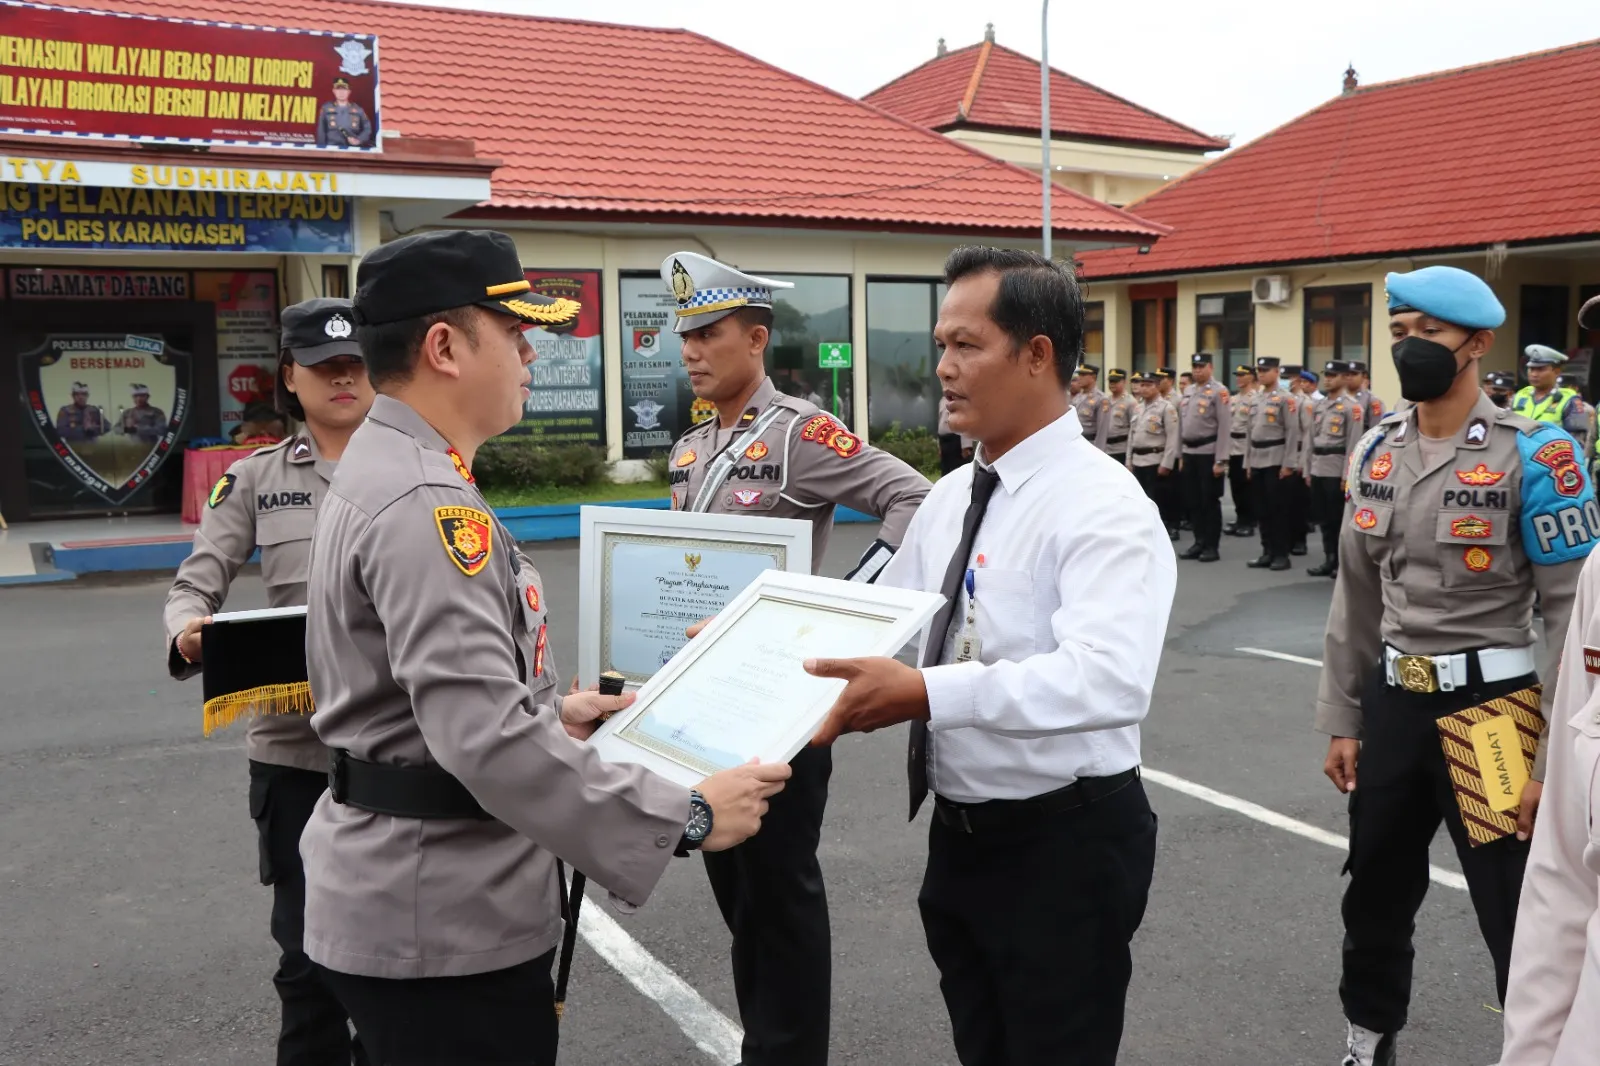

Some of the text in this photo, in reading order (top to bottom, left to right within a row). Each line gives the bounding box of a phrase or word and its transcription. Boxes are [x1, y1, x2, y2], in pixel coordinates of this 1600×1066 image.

[86, 43, 160, 79] WILAYAH
[164, 50, 212, 82] BEBAS
[215, 54, 250, 86] DARI
[252, 58, 314, 89] KORUPSI
[0, 75, 318, 125] ILAYAH BIROKRASI BERSIH DAN MELAYANI
[131, 164, 338, 192] SUDHIRAJATI
[38, 183, 216, 217] PELAYANAN
[222, 191, 345, 221] TERPADU
[21, 218, 246, 245] POLRES KARANGASEM
[16, 274, 186, 297] SELAMAT DATANG
[623, 311, 669, 319] PELAYANAN
[52, 340, 91, 350] POLRES
[127, 338, 162, 352] BUKA
[70, 357, 146, 369] BERSEMADI
[639, 360, 672, 368] RESKRIM
[726, 464, 781, 480] POLRI
[257, 492, 312, 511] KADEK
[1443, 489, 1508, 509] POLRI
[440, 508, 488, 525] RESERSE
[1532, 500, 1600, 554] PRO
[1486, 731, 1514, 796] AMANAT
